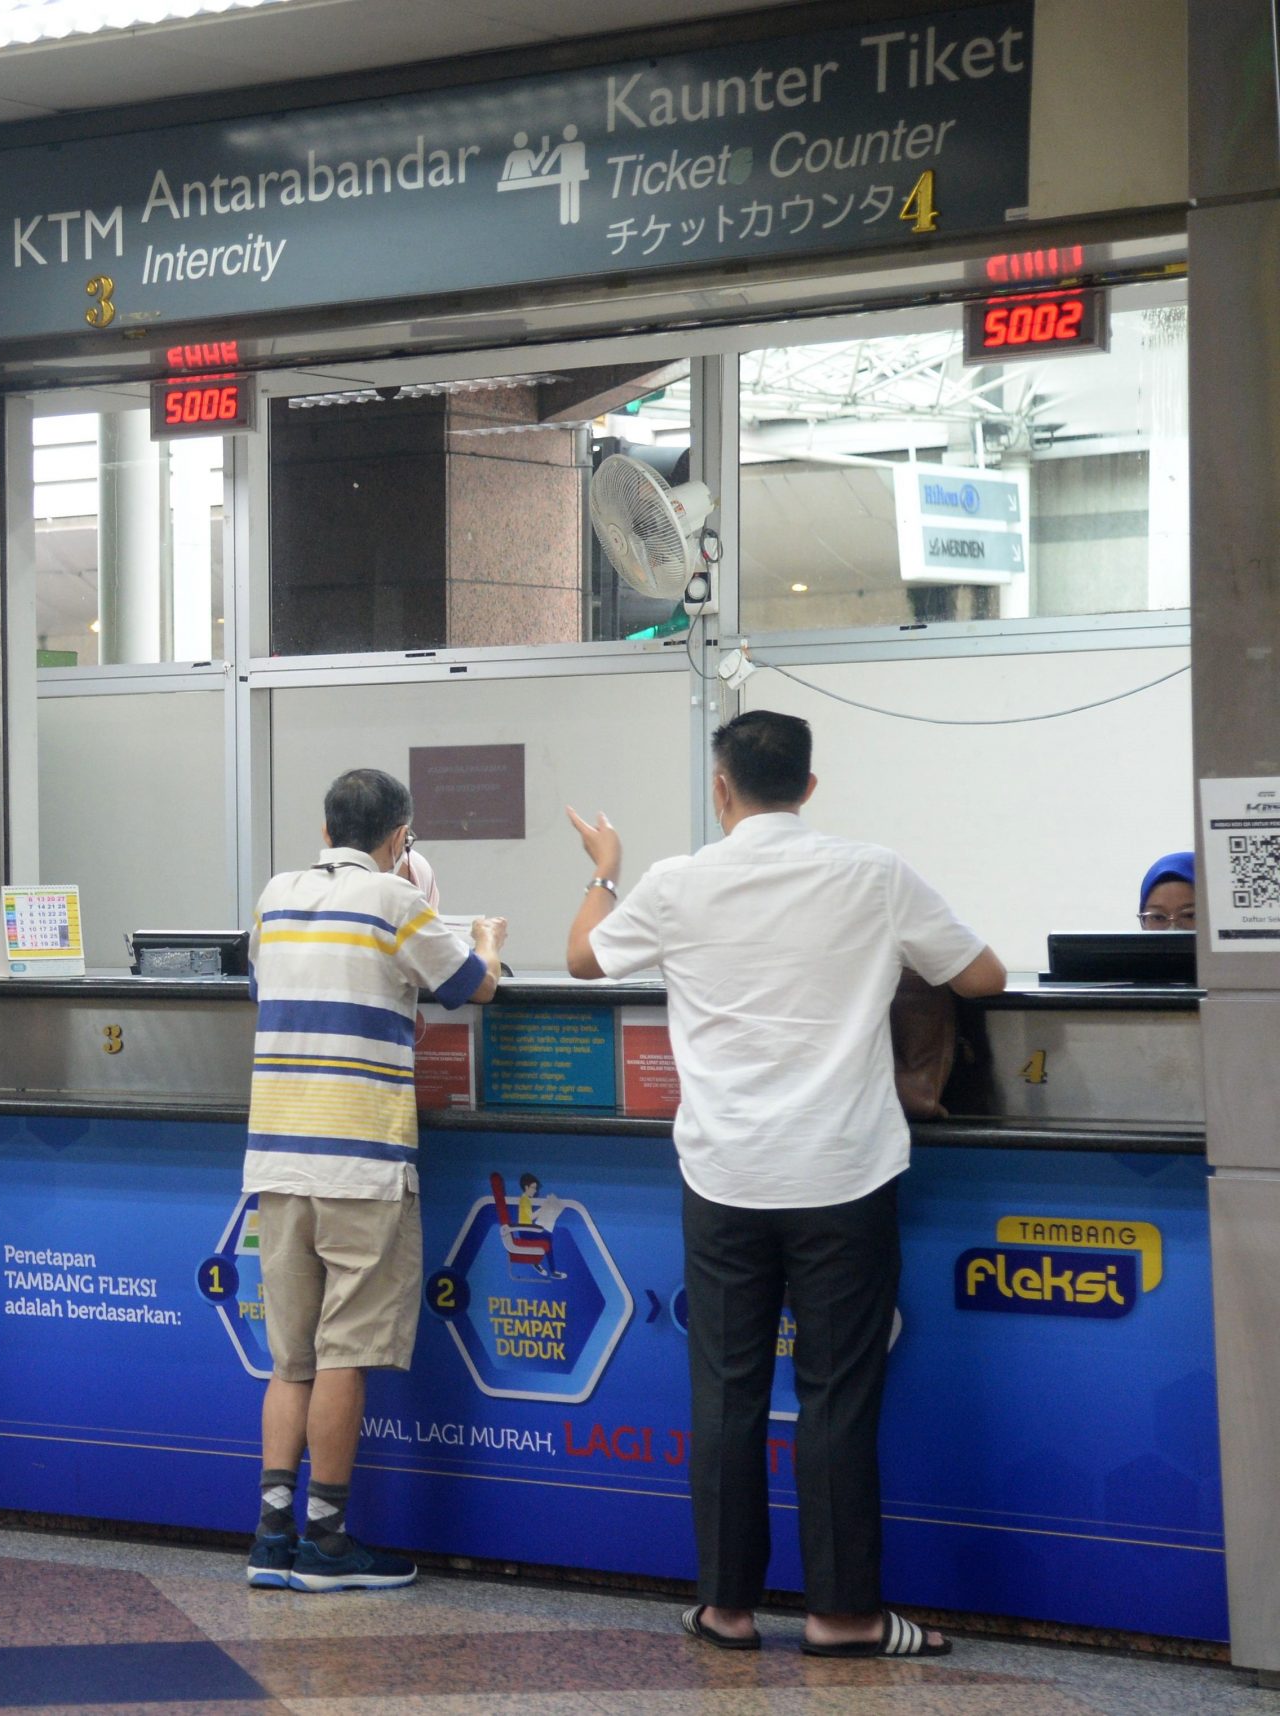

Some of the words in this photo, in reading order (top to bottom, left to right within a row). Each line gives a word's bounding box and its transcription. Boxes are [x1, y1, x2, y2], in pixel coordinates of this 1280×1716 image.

[606, 58, 839, 133] Kaunter
[860, 26, 1024, 93] Tiket
[607, 149, 733, 200] Ticket
[769, 118, 956, 179] Counter
[141, 134, 481, 224] Antarabandar
[606, 183, 905, 256] チケットカウンタ
[899, 169, 940, 235] 4
[13, 205, 124, 267] KTM
[142, 232, 287, 285] Intercity
[85, 274, 115, 328] 3
[983, 300, 1084, 348] 5002
[166, 385, 238, 424] 5006
[102, 1024, 124, 1055] 3
[1019, 1221, 1137, 1245] TAMBANG
[4, 1244, 97, 1271] Penetapan
[4, 1270, 95, 1294] TAMBANG
[99, 1275, 157, 1298] FLEKSI
[208, 1265, 224, 1294] 1
[436, 1278, 456, 1308] 2
[4, 1297, 63, 1318] adalah
[66, 1299, 182, 1326] berdasarkan:
[487, 1296, 567, 1320] PILIHAN
[489, 1316, 566, 1340] TEMPAT
[495, 1338, 566, 1361] DUDUK
[416, 1423, 465, 1447] LAGI
[470, 1426, 557, 1458] MURAH,
[563, 1420, 653, 1463] LAGI
